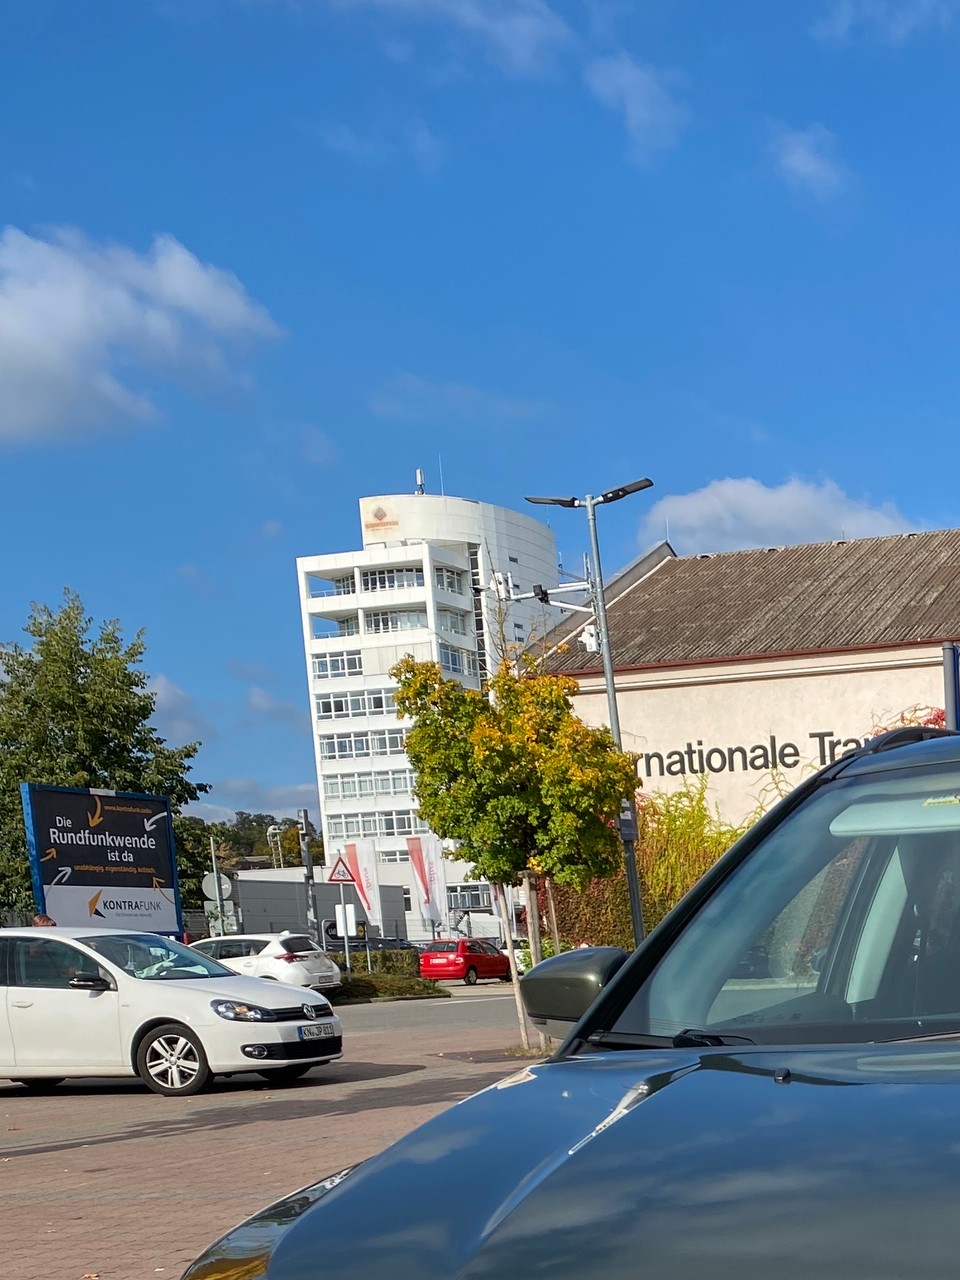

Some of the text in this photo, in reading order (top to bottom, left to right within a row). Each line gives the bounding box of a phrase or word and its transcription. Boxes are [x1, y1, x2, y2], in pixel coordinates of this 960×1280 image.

[55, 816, 72, 828] Die
[49, 828, 156, 849] Rundfunkwende
[107, 850, 134, 862] ist da
[102, 900, 162, 911] KONTRAFUNK
